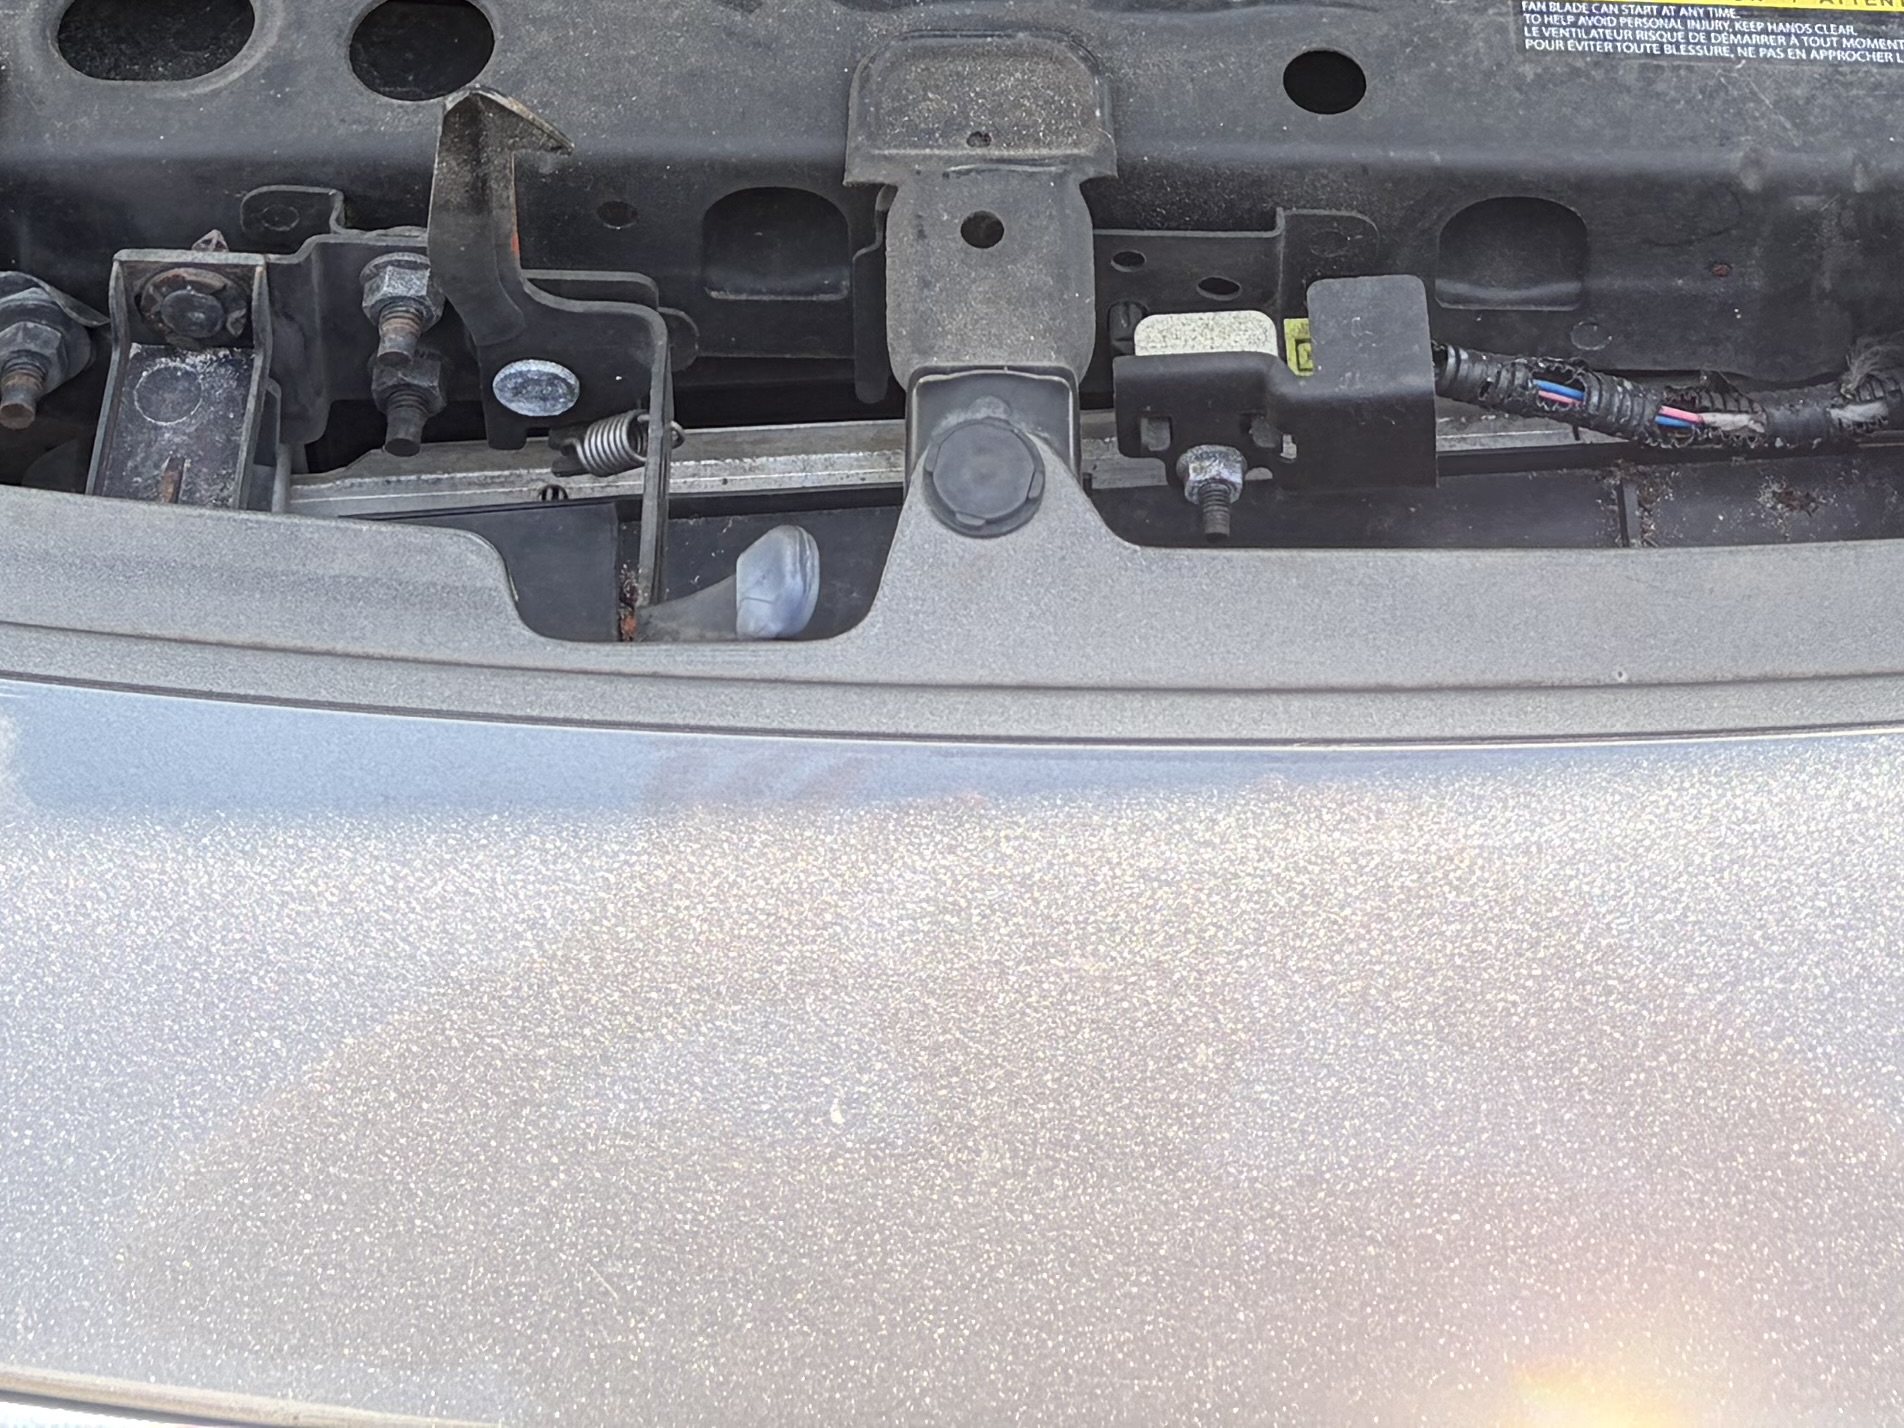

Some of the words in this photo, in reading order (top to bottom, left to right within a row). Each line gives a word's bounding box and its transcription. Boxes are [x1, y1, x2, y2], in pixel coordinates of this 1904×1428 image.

[1522, 1, 1547, 12] FAN
[1549, 2, 1589, 13] BLADE
[1591, 3, 1619, 14] CAN
[1620, 4, 1658, 16] START
[1662, 6, 1677, 16] AT
[1680, 6, 1705, 17] ANY
[1707, 7, 1740, 19] TIME.
[1523, 13, 1542, 25] TO
[1544, 15, 1575, 26] HELP
[1578, 16, 1616, 27] AVOID
[1620, 17, 1682, 30] PERSONAL
[1734, 21, 1764, 32] KEEP
[1767, 23, 1812, 34] HANDS
[1815, 24, 1857, 36] CLEAR.
[1524, 26, 1540, 37] LE
[1543, 27, 1632, 41] VENTILATEUR
[1636, 30, 1685, 43] RISQUE
[1688, 32, 1707, 43] DE
[1711, 31, 1790, 46] DÉMARRER
[1790, 34, 1801, 45] À
[1802, 36, 1838, 48] TOUT
[1525, 39, 1564, 51] POUR
[1567, 38, 1613, 52] ÉVITER
[1616, 42, 1660, 54] TOUTE
[1738, 47, 1756, 58] NE
[1759, 48, 1785, 59] PAS
[1788, 49, 1806, 60] EN
[1810, 50, 1894, 63] APPROCHER
